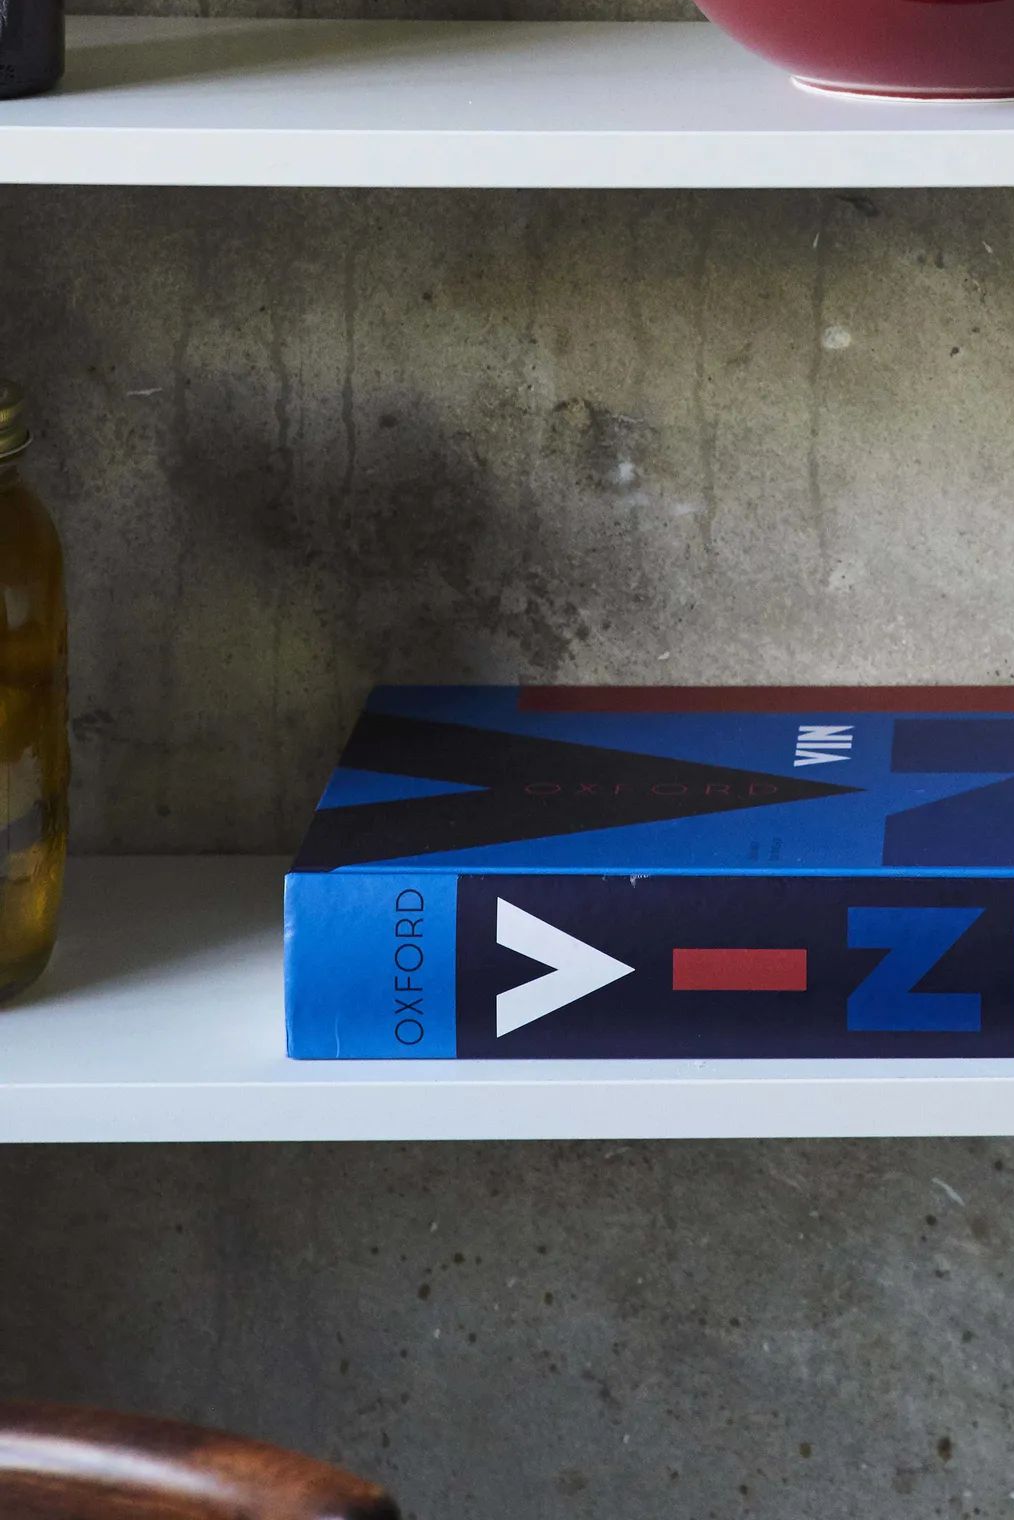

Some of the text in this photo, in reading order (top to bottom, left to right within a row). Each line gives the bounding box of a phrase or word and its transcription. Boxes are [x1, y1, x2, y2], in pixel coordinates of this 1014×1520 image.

[793, 725, 855, 767] VIN
[523, 782, 778, 797] OXFORD
[394, 887, 424, 1046] OXFORD
